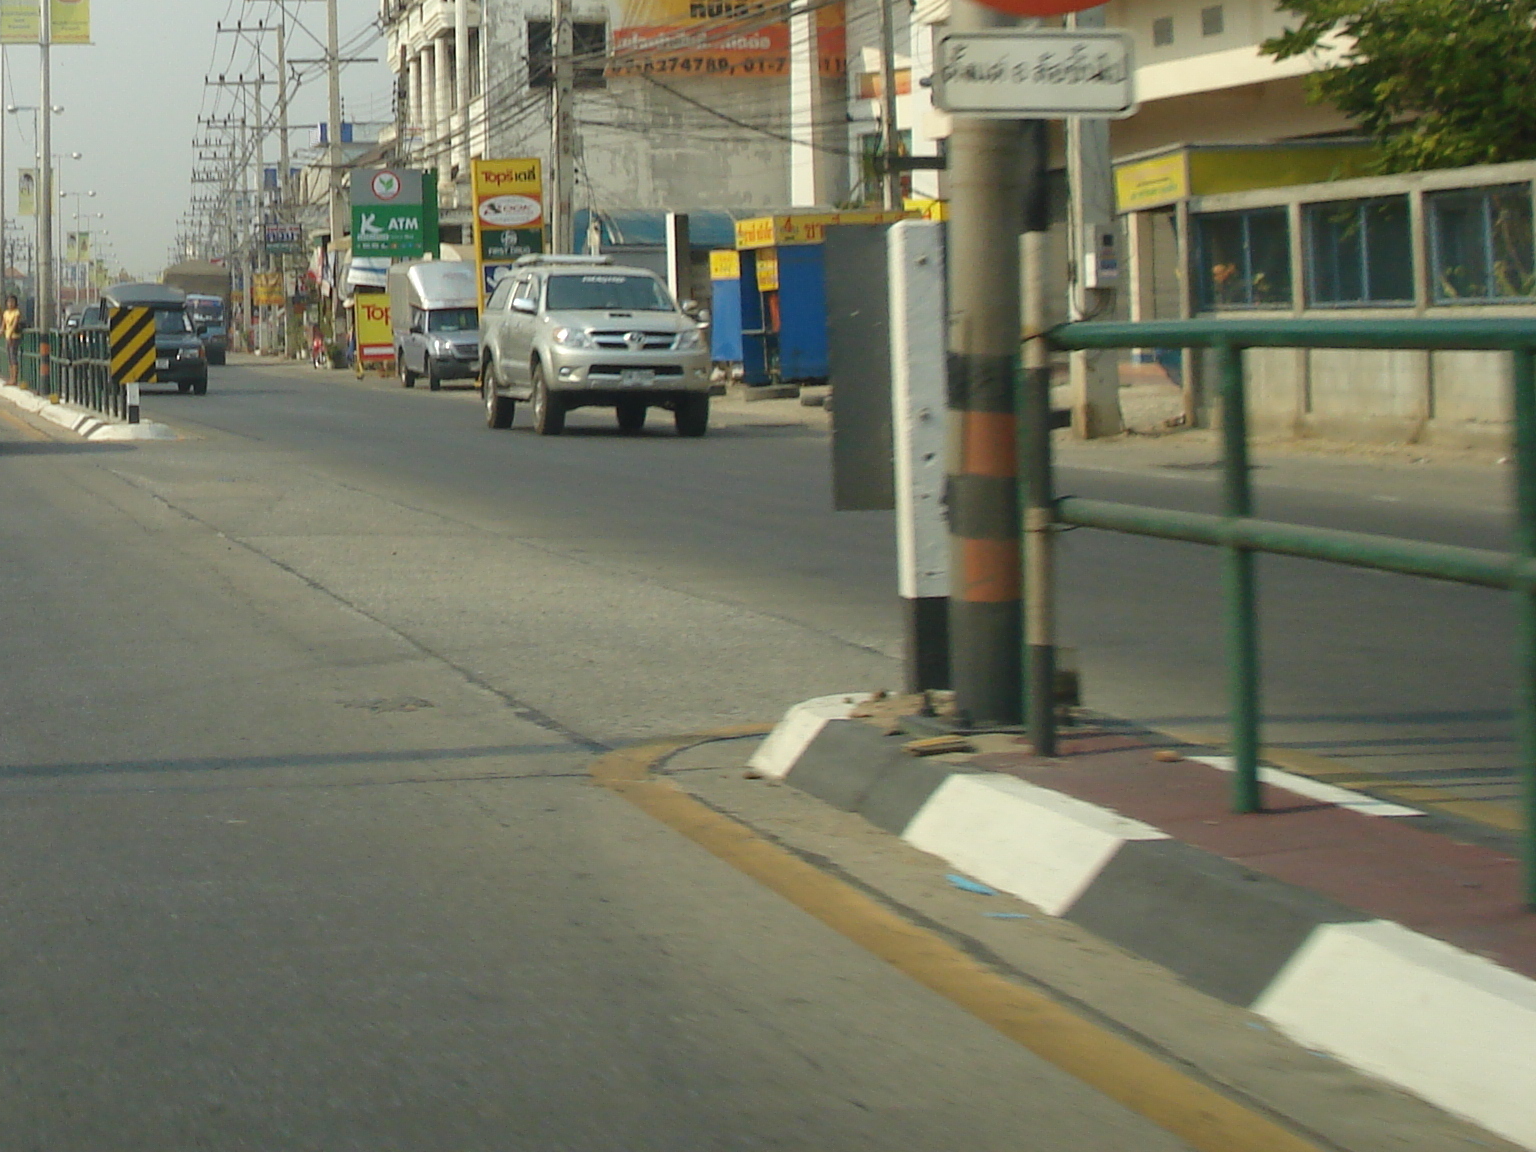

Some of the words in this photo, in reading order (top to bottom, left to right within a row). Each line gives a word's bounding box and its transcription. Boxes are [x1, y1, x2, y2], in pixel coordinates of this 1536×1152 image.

[481, 169, 514, 187] Tops
[360, 212, 384, 235] K
[388, 217, 419, 230] ATM
